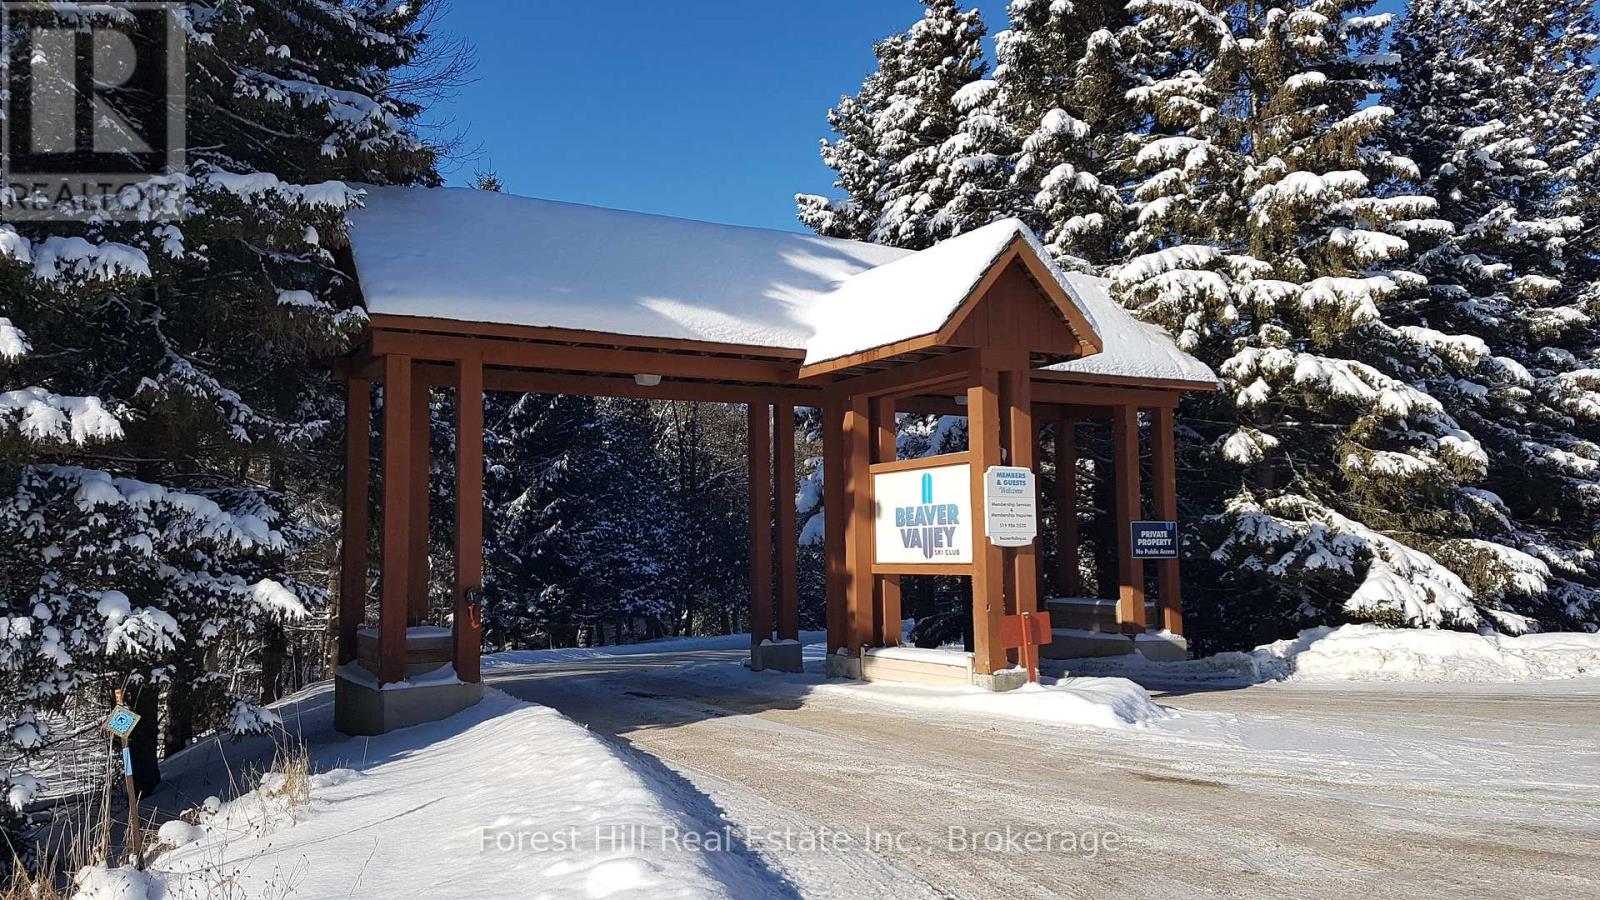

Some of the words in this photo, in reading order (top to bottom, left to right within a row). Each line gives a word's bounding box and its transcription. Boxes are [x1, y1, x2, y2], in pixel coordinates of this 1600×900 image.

[895, 504, 960, 527] BEAVER
[1141, 530, 1168, 538] PRIVATE
[900, 526, 956, 559] VALLEY
[1137, 538, 1172, 546] PROPERTY
[945, 548, 960, 556] CLUB
